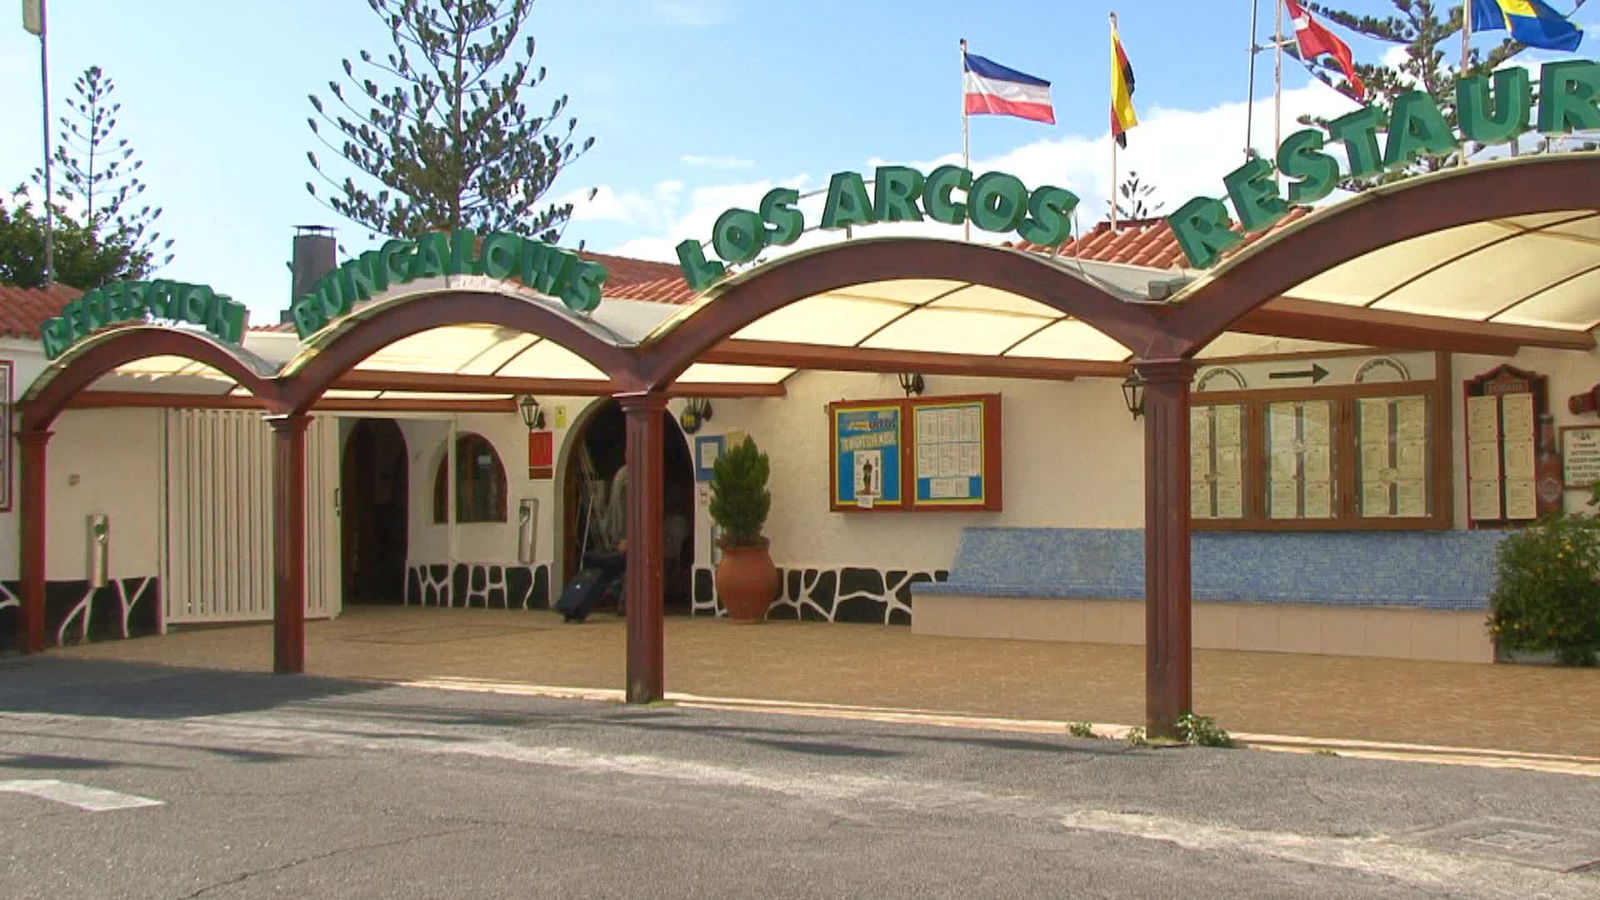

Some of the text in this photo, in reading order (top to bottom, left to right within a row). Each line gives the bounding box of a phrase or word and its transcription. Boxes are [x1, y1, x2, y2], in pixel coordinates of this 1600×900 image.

[293, 228, 609, 340] BUNGALOWS
[676, 165, 1080, 291] LOS ARCOS
